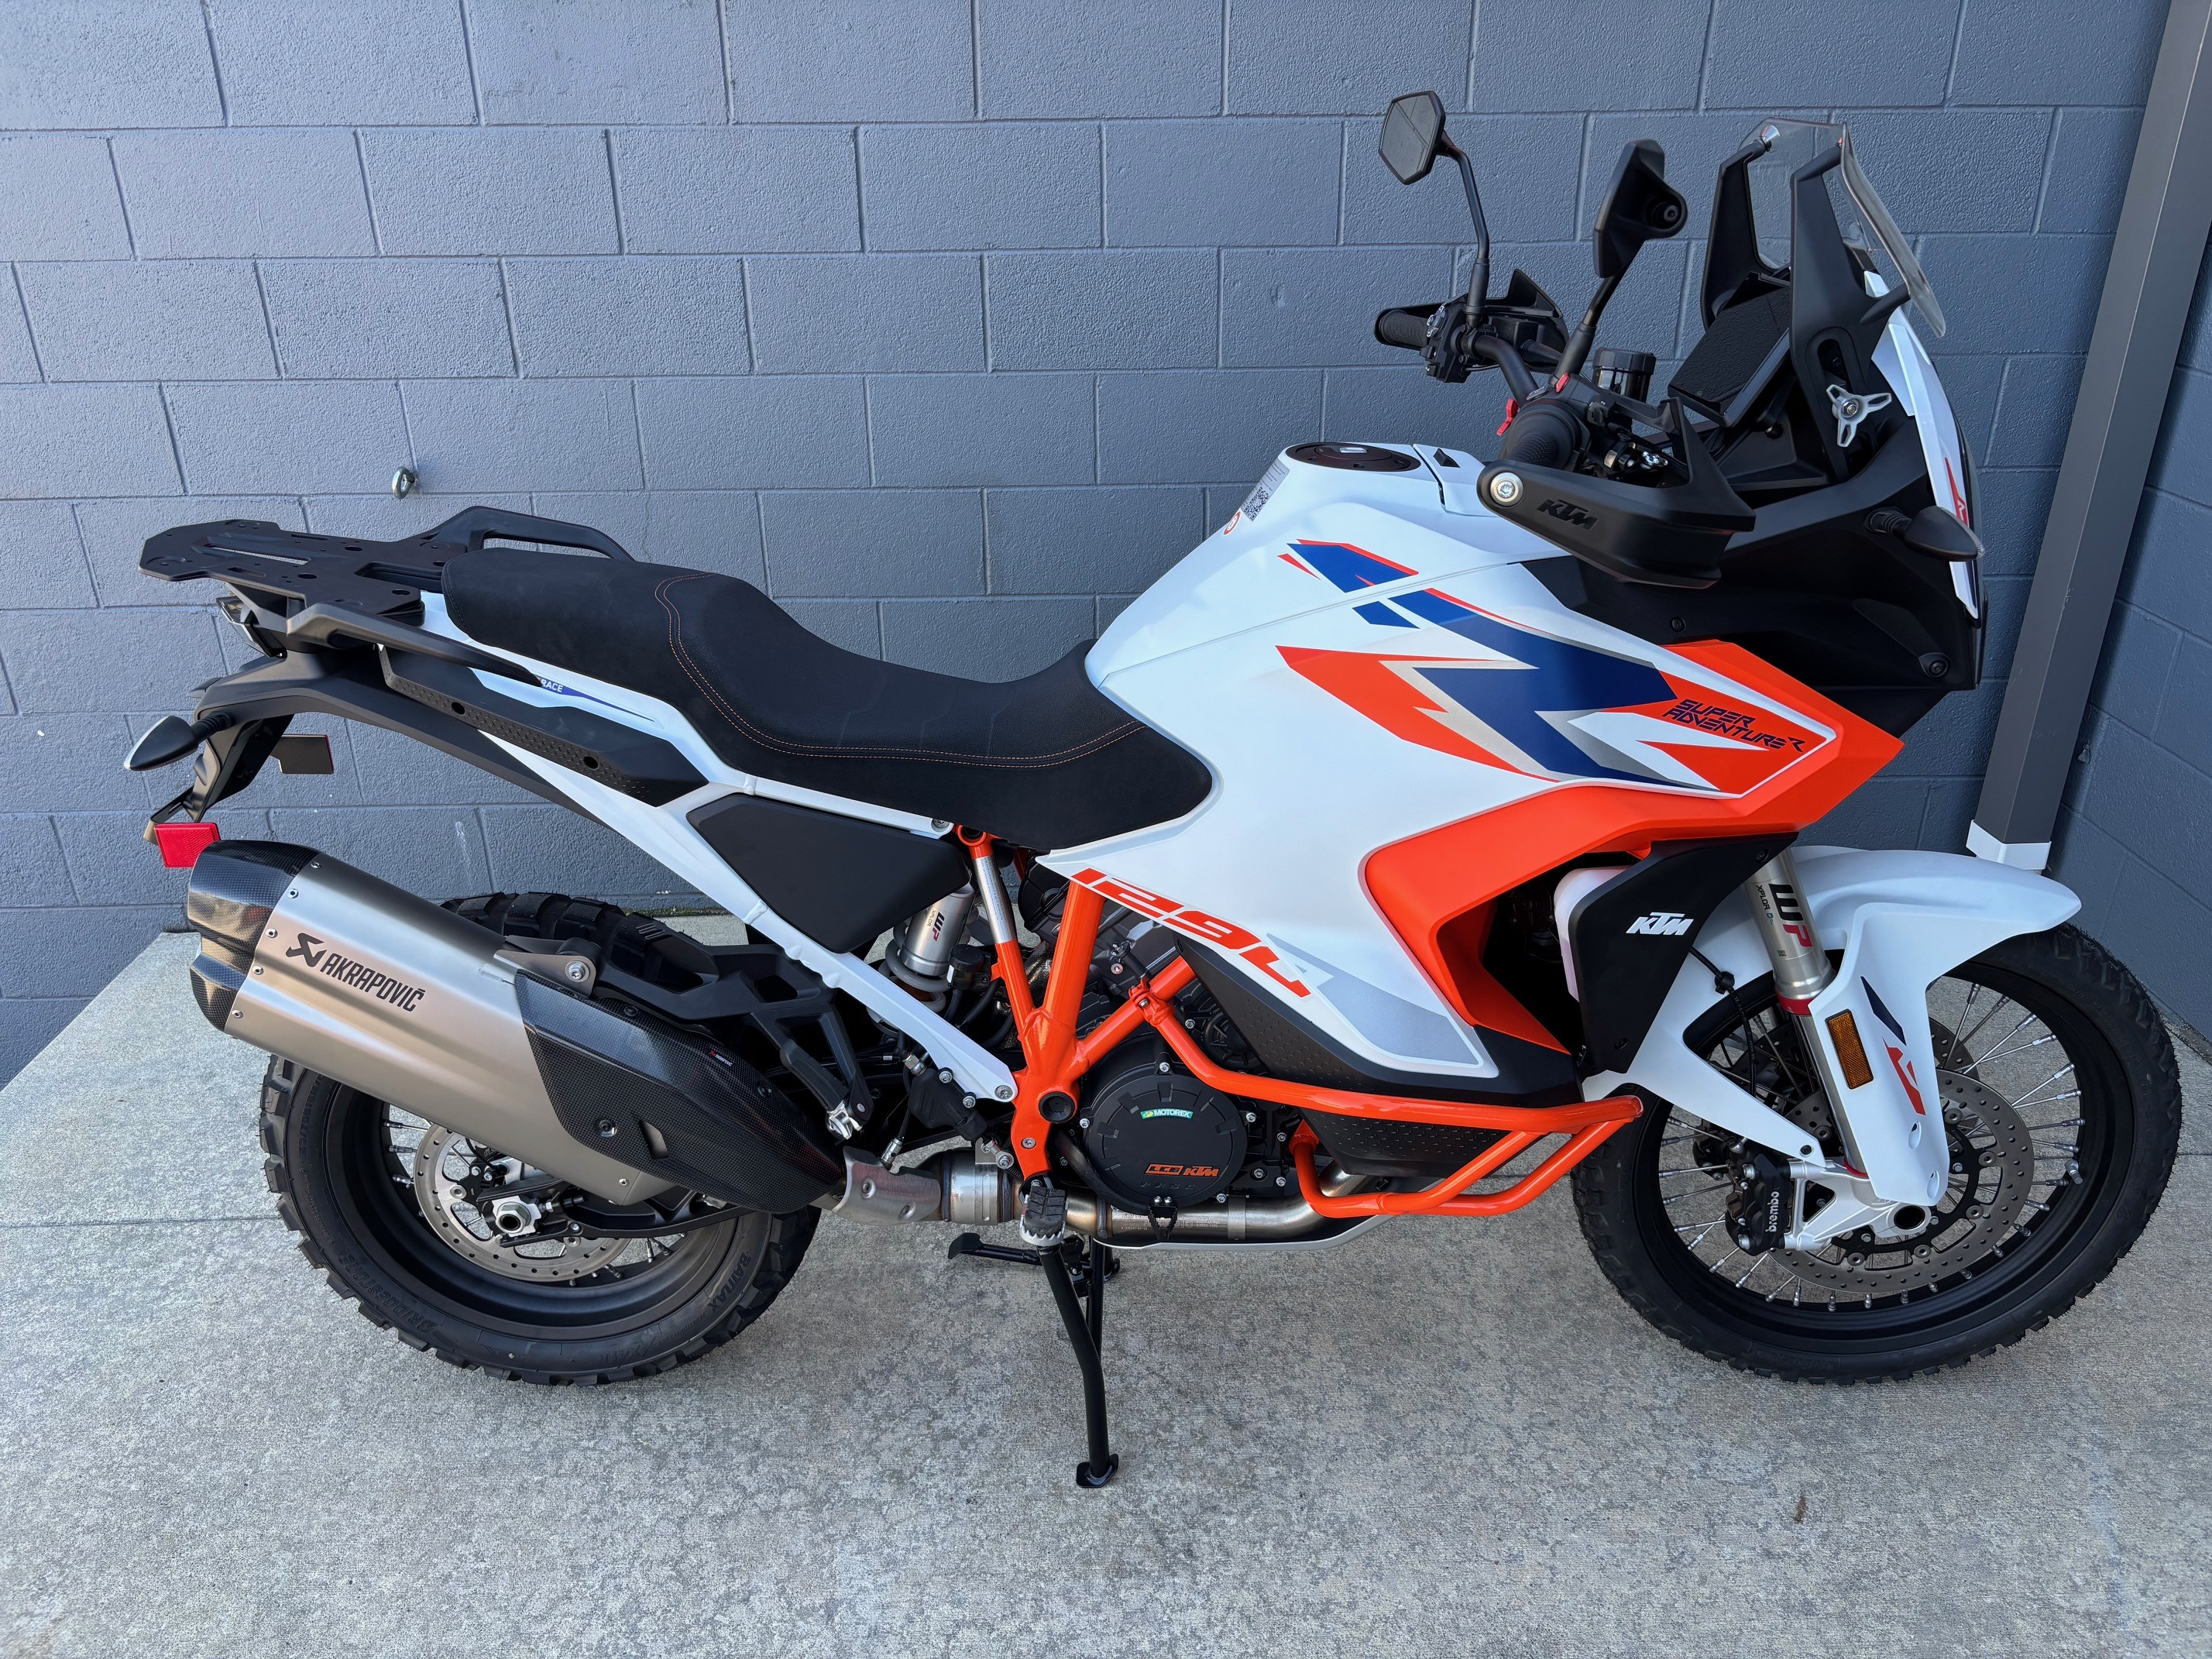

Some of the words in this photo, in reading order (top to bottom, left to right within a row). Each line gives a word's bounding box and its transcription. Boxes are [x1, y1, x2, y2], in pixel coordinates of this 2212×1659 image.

[1537, 499, 1599, 531] KTM
[541, 678, 564, 692] RACE
[1674, 699, 1756, 728] SUPER
[1661, 708, 1787, 750] ADVENTURE
[1755, 884, 1771, 911] XPLOR
[932, 912, 945, 941] WP
[1625, 912, 1695, 936] KTM
[1768, 883, 1812, 947] WP
[1154, 1108, 1190, 1118] MOTOREX
[1183, 1166, 1219, 1176] KTM
[1765, 1191, 1780, 1232] brembo
